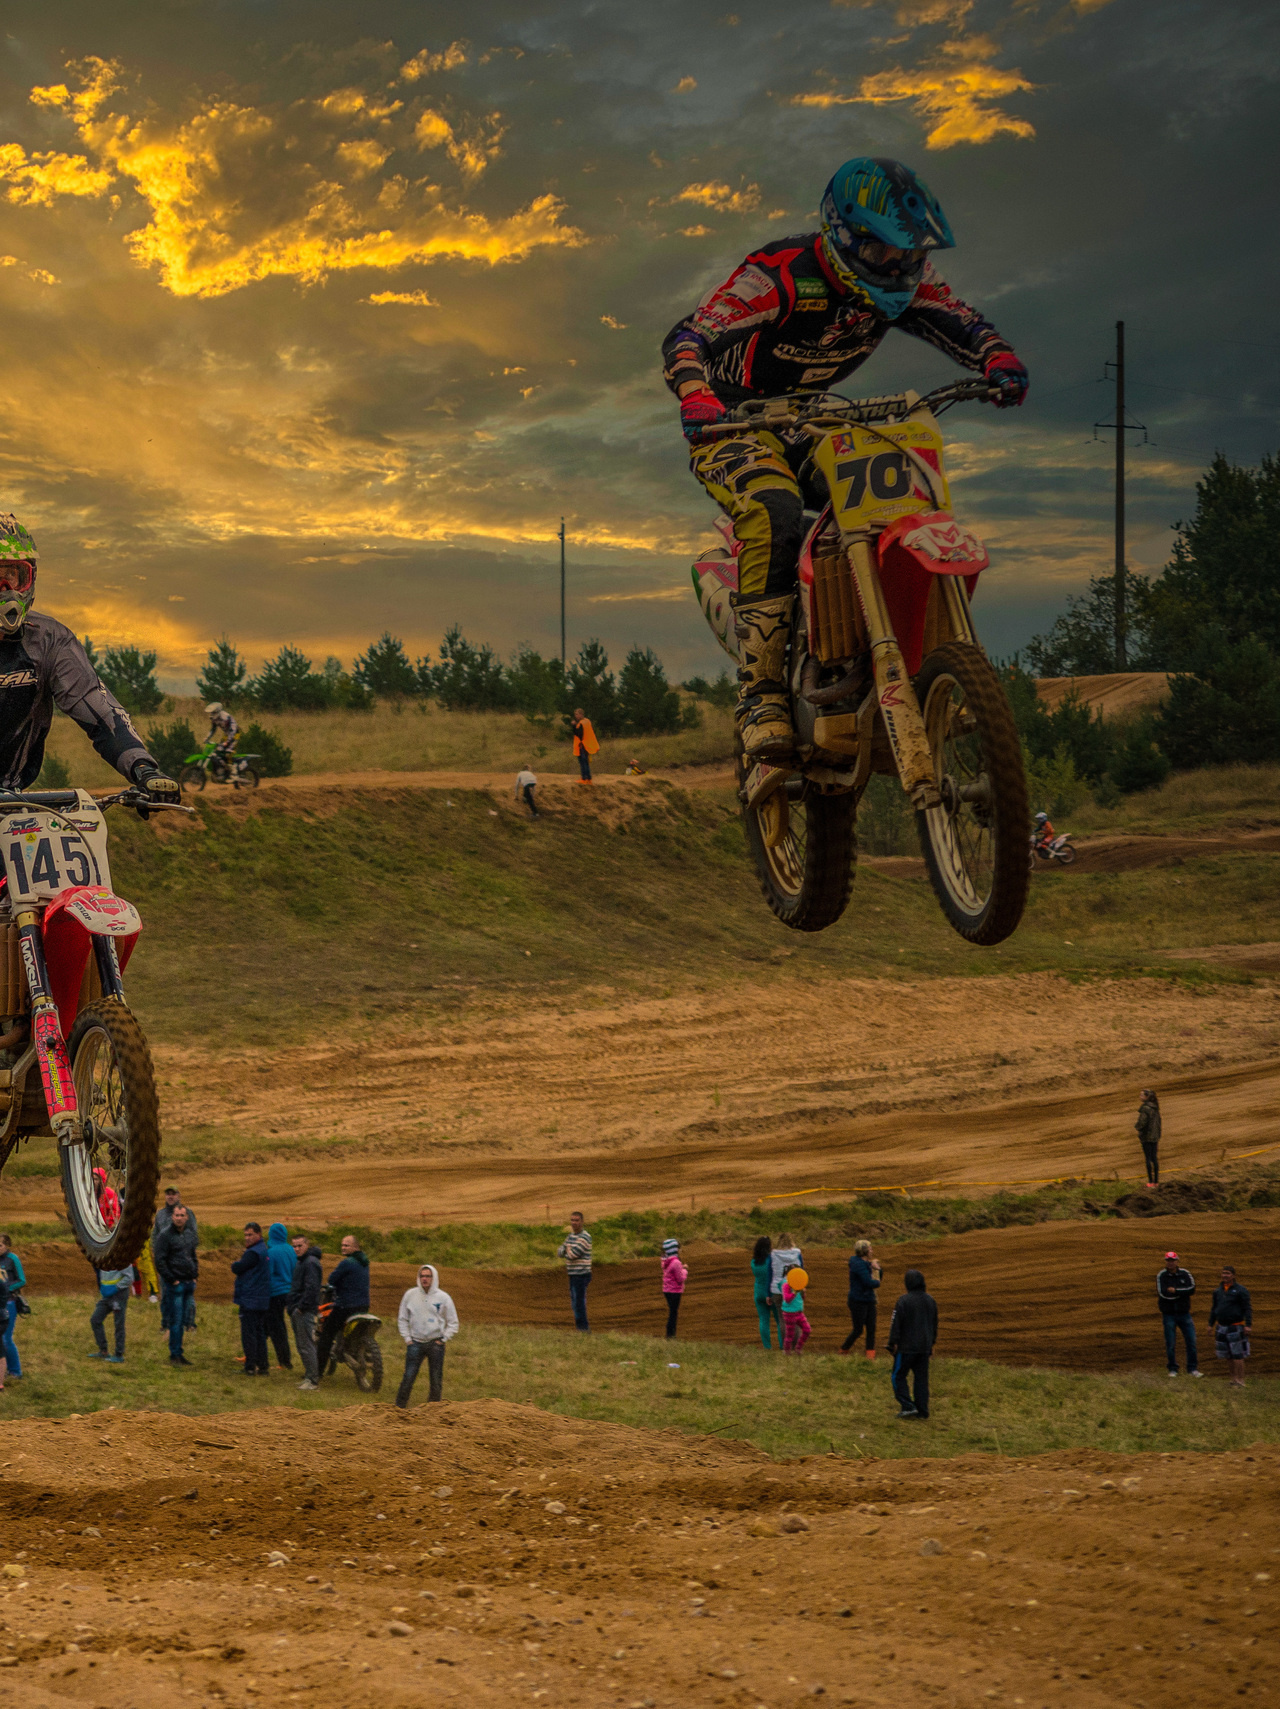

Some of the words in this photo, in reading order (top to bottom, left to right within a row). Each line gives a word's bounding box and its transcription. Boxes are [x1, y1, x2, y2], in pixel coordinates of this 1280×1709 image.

[835, 451, 911, 511] 70
[10, 837, 90, 895] 145
[73, 901, 92, 921] DUNLOP
[49, 1063, 65, 1107] CIRCUIT
